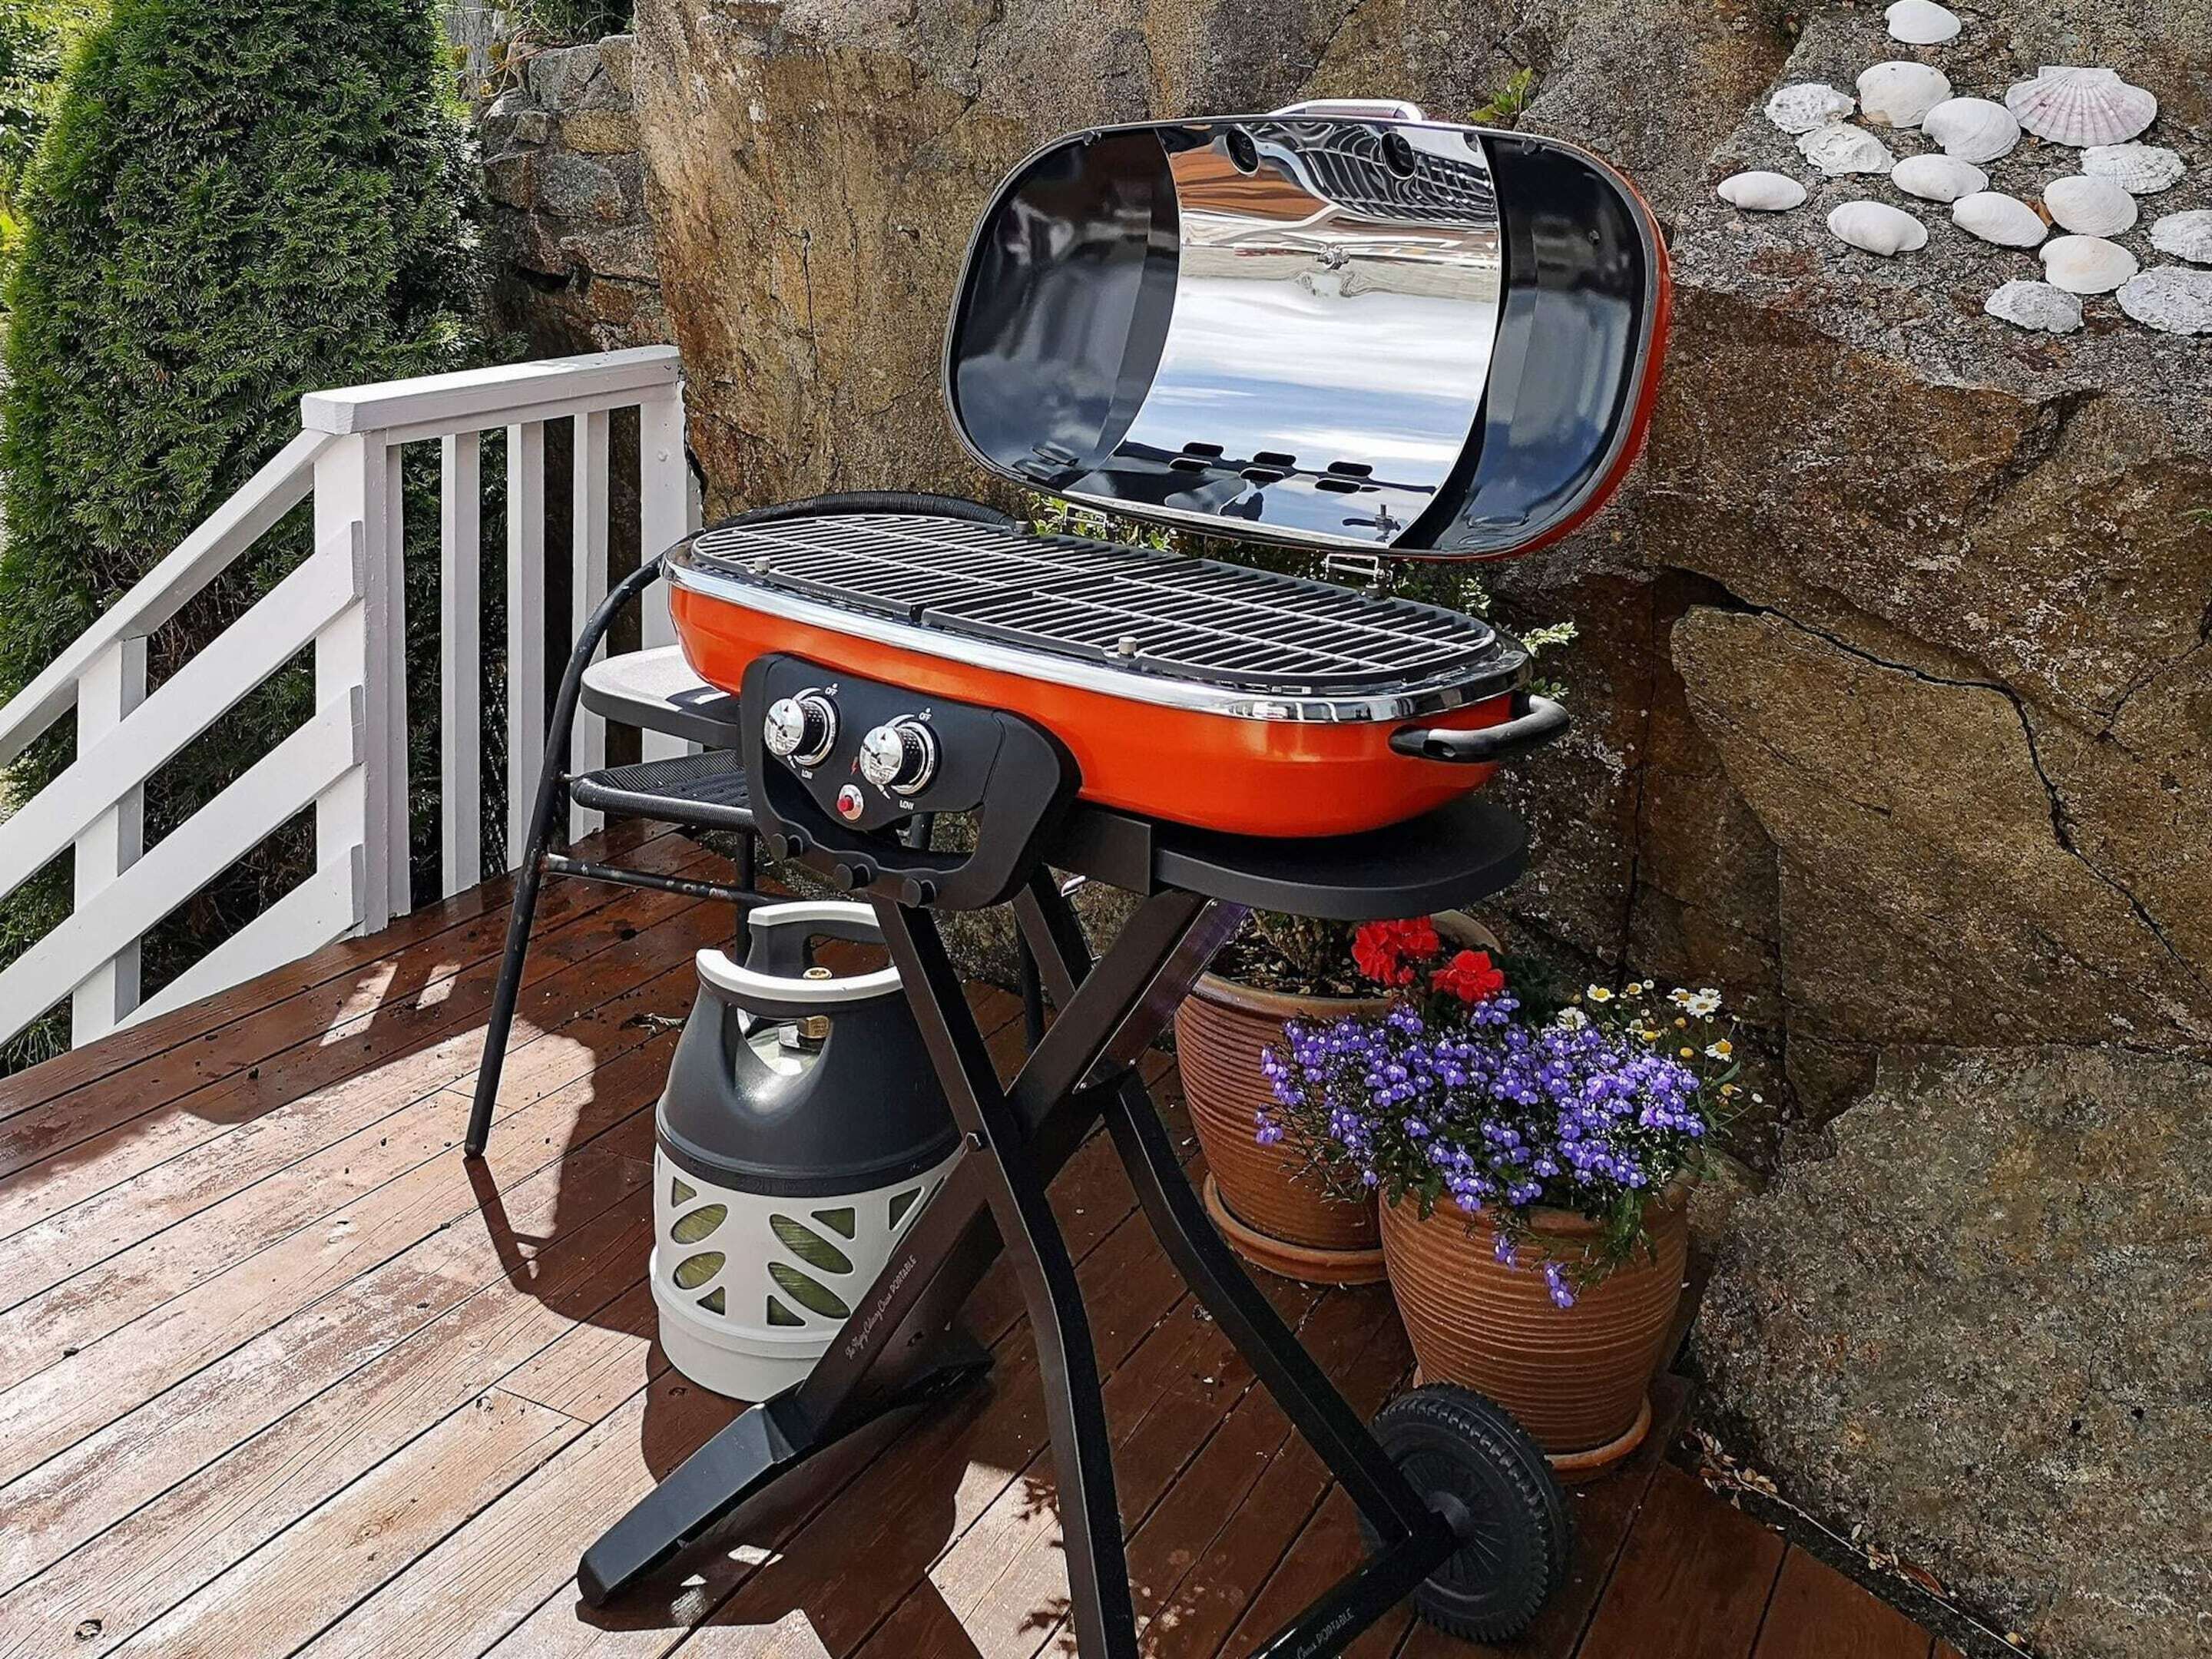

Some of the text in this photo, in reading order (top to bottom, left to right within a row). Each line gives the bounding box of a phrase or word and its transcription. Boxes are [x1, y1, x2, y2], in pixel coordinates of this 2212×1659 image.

[825, 687, 838, 696] OFF
[919, 712, 932, 722] OFF
[899, 800, 915, 810] LOW
[889, 1254, 917, 1293] PORTABLE
[1316, 1608, 1355, 1646] PORTABLE
